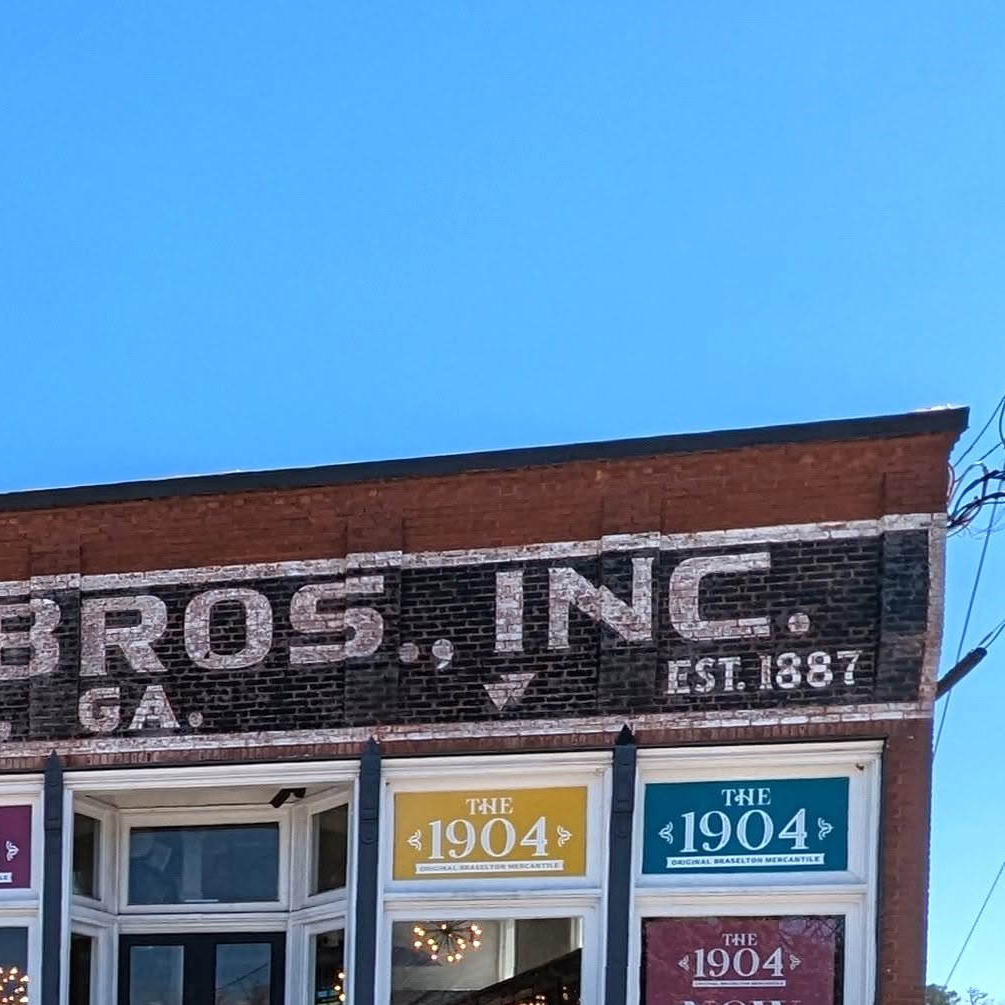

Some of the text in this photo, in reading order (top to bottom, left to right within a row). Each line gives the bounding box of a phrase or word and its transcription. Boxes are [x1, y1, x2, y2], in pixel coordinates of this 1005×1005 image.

[493, 551, 811, 654] INC.
[666, 650, 863, 694] EST. 1887
[77, 684, 203, 734] GA.
[465, 797, 514, 816] THE
[720, 787, 772, 807] THE
[428, 816, 549, 860] 1904
[679, 808, 810, 853] 1904
[671, 855, 821, 866] ORIGINAL BRASELTON MERCANTILE
[721, 932, 758, 947] THE
[693, 947, 785, 978] 1904
